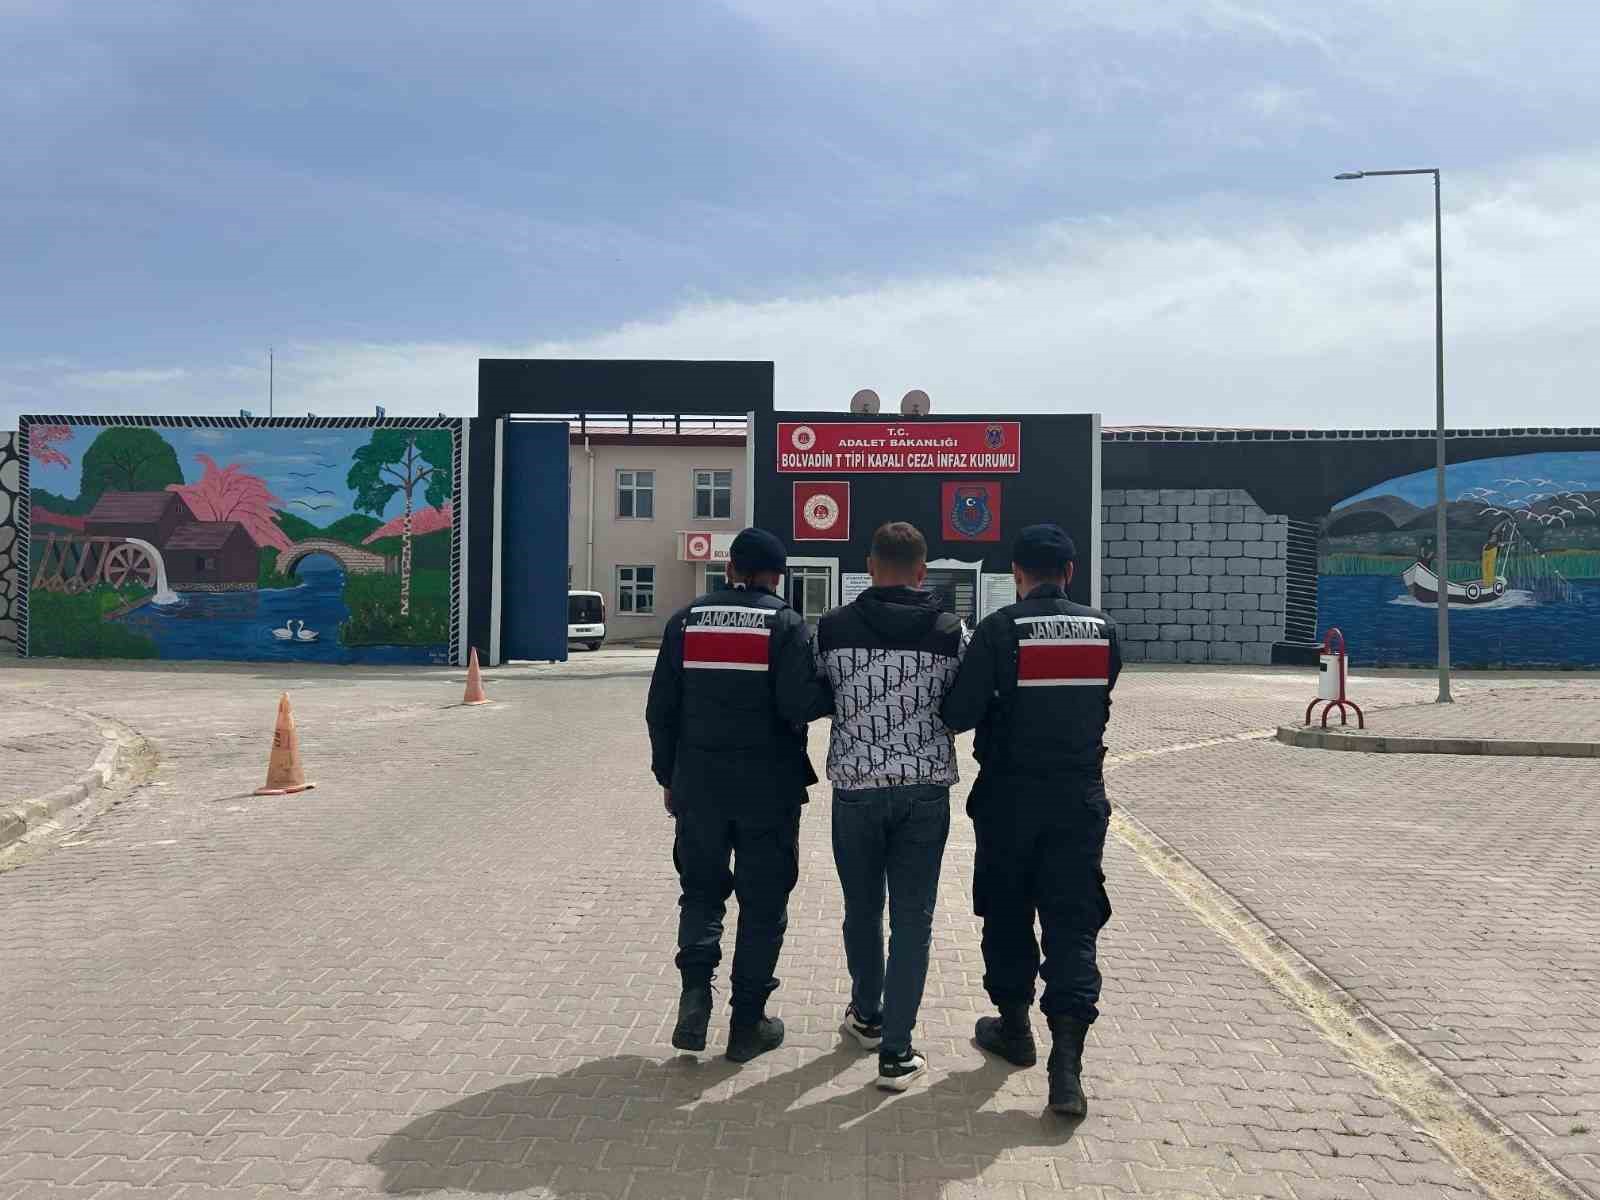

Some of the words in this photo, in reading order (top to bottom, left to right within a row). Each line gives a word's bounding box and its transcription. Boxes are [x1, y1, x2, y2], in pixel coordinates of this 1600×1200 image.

[887, 427, 909, 436] T.C.
[838, 439, 887, 447] ADALET
[890, 437, 958, 447] BAKANLIĞI
[781, 450, 833, 468] BOLVADİN
[835, 453, 842, 467] T
[844, 450, 865, 468] TİPİ
[867, 453, 904, 468] KAPALI
[907, 453, 935, 468] CEZA
[937, 450, 967, 468] İNFAZ
[969, 453, 1016, 468] KURUMU
[696, 611, 767, 628] JANDARMA
[1029, 622, 1101, 639] JANDARMA
